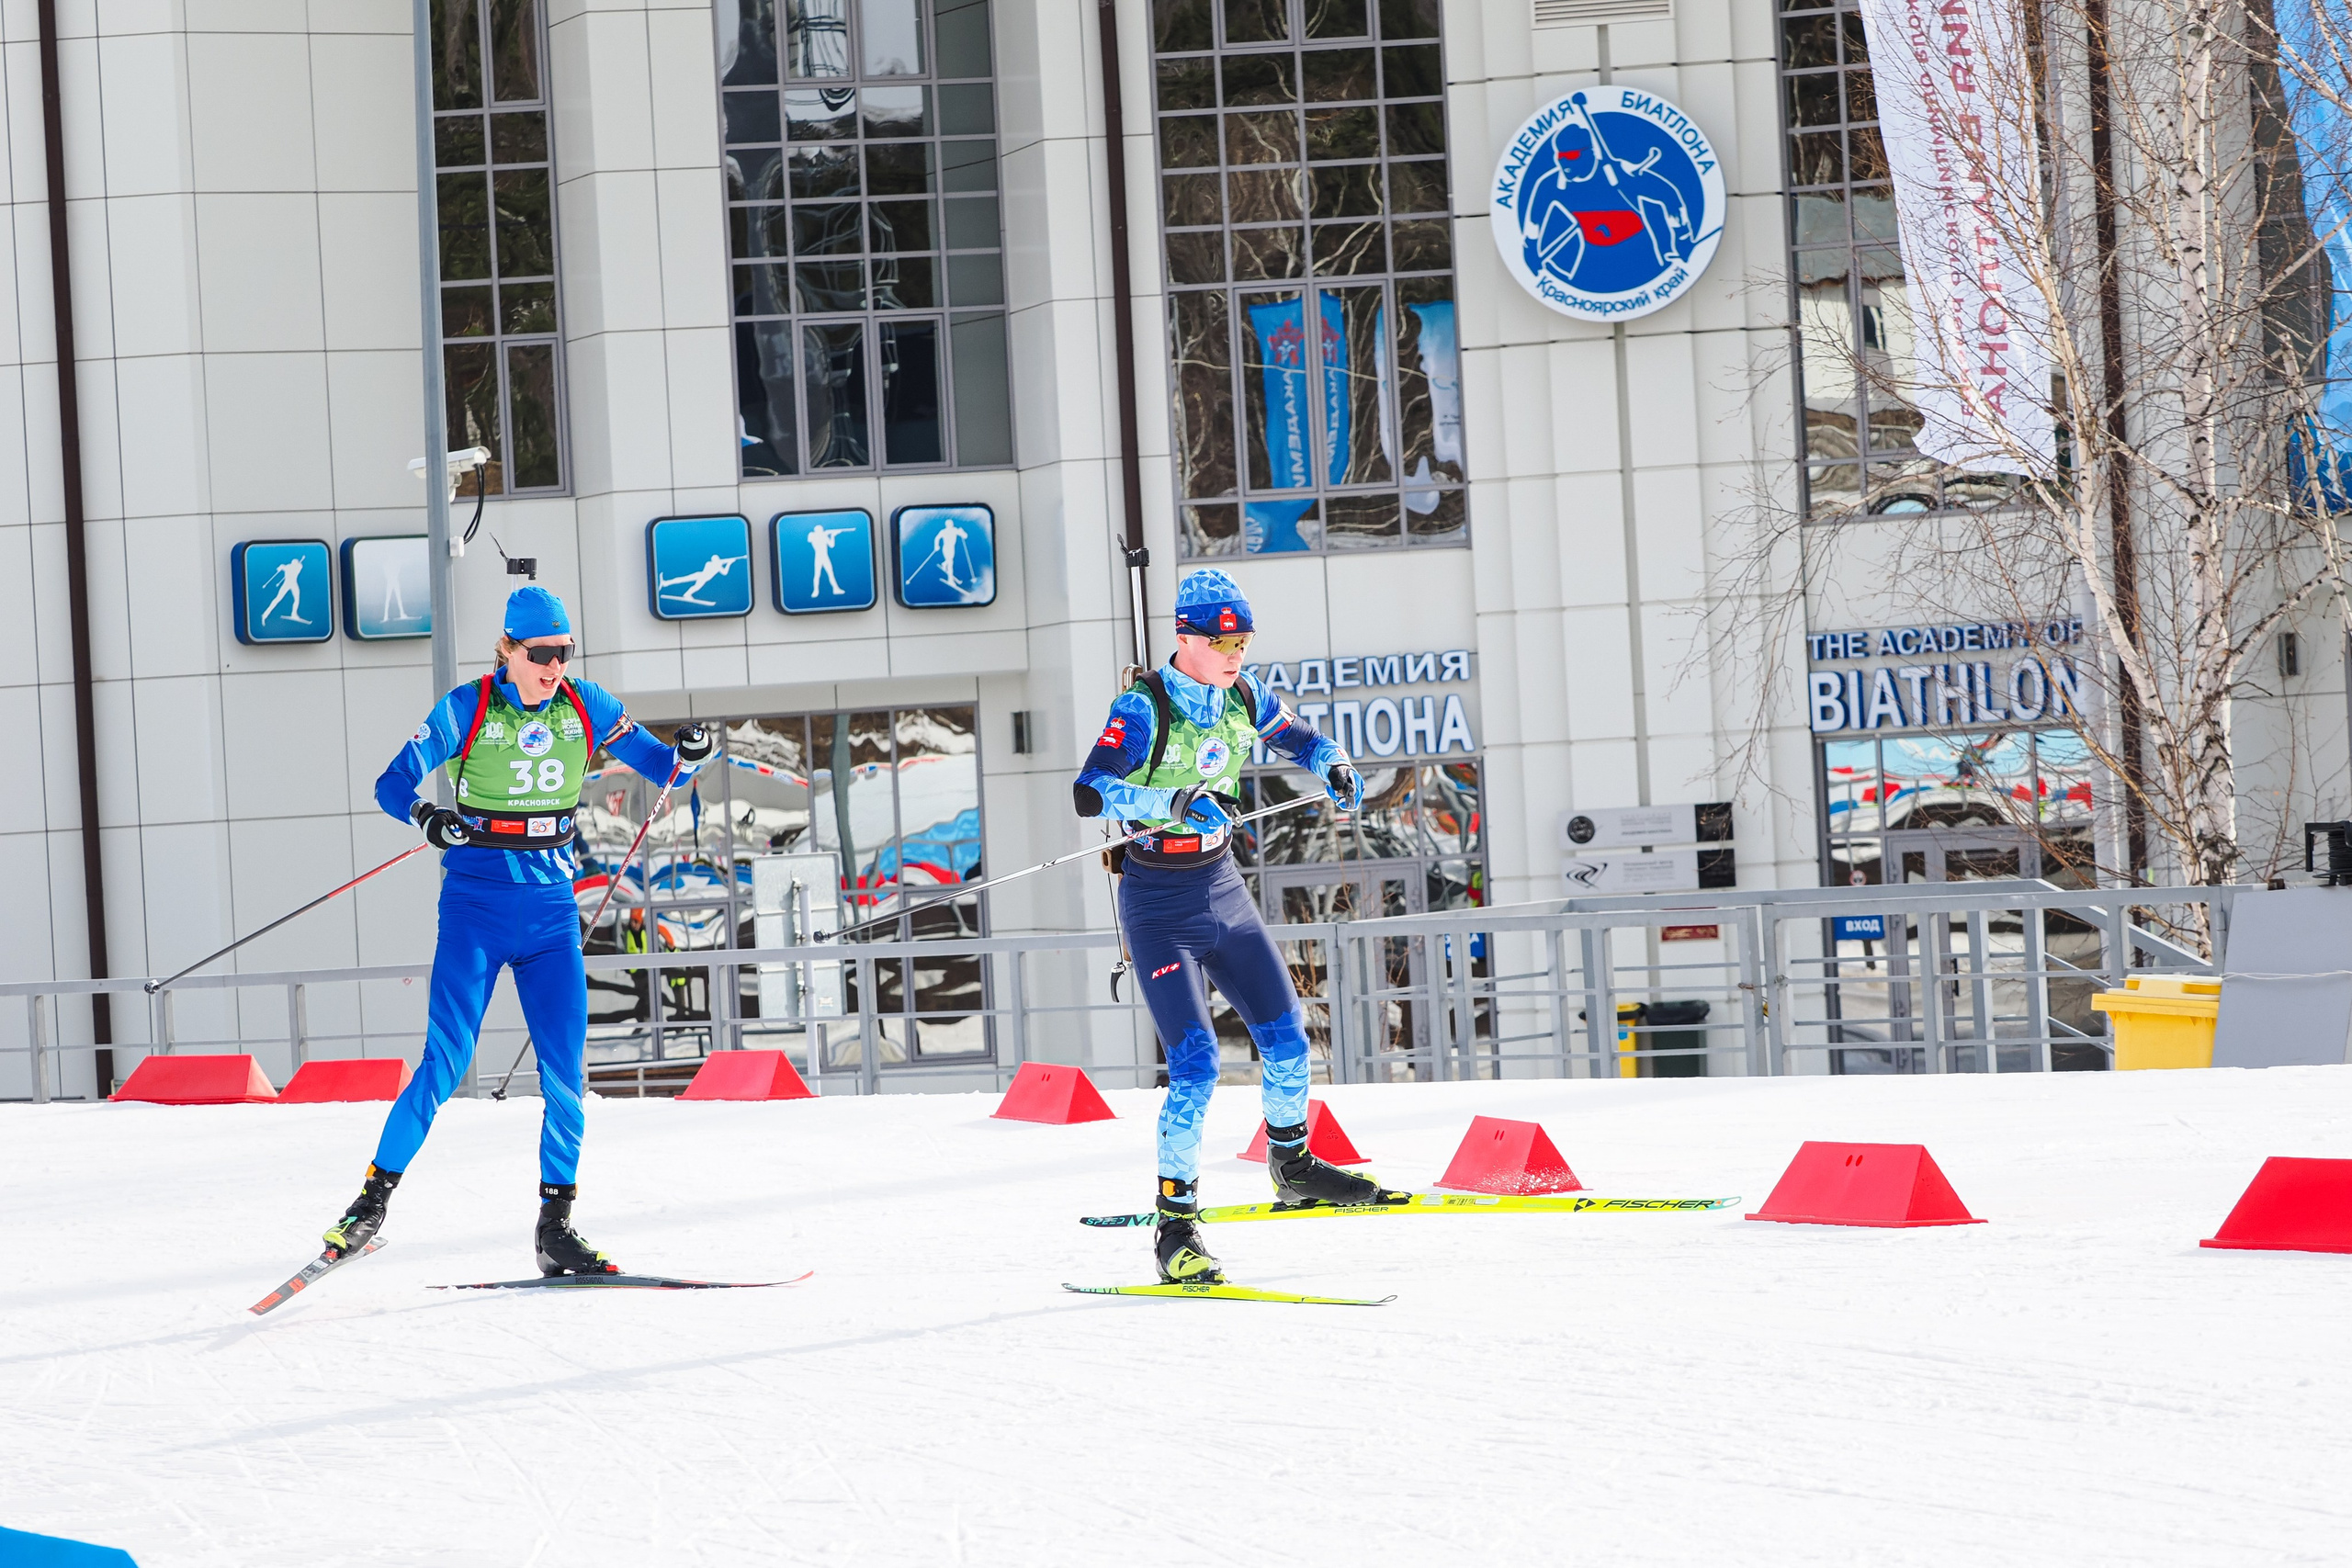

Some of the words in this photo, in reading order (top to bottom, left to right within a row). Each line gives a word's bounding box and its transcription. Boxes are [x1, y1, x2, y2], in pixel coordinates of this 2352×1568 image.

[1496, 99, 1575, 209] АКАДЕМИЯ
[1621, 91, 1715, 175] БИАТЛОНА
[1536, 276, 1651, 316] Красноярский
[1655, 266, 1690, 299] край
[1807, 631, 1870, 660] THE
[1876, 621, 2034, 656] ACADEMY
[2043, 618, 2083, 647] OF
[1246, 649, 1471, 697] АДЕМИЯ
[1809, 655, 2087, 733] BIATHLON
[508, 758, 565, 795] 38
[507, 798, 560, 807] КРАСНОЯРСК
[1845, 919, 1881, 933] ВХОД
[544, 1187, 559, 1195] 188
[1334, 1206, 1389, 1214] FISCHER
[1603, 1200, 1714, 1210] FISCHER
[1160, 1209, 1196, 1219] FISCHER
[575, 1277, 605, 1285] ROSSIGNOL
[1182, 1285, 1211, 1293] FISCHER
